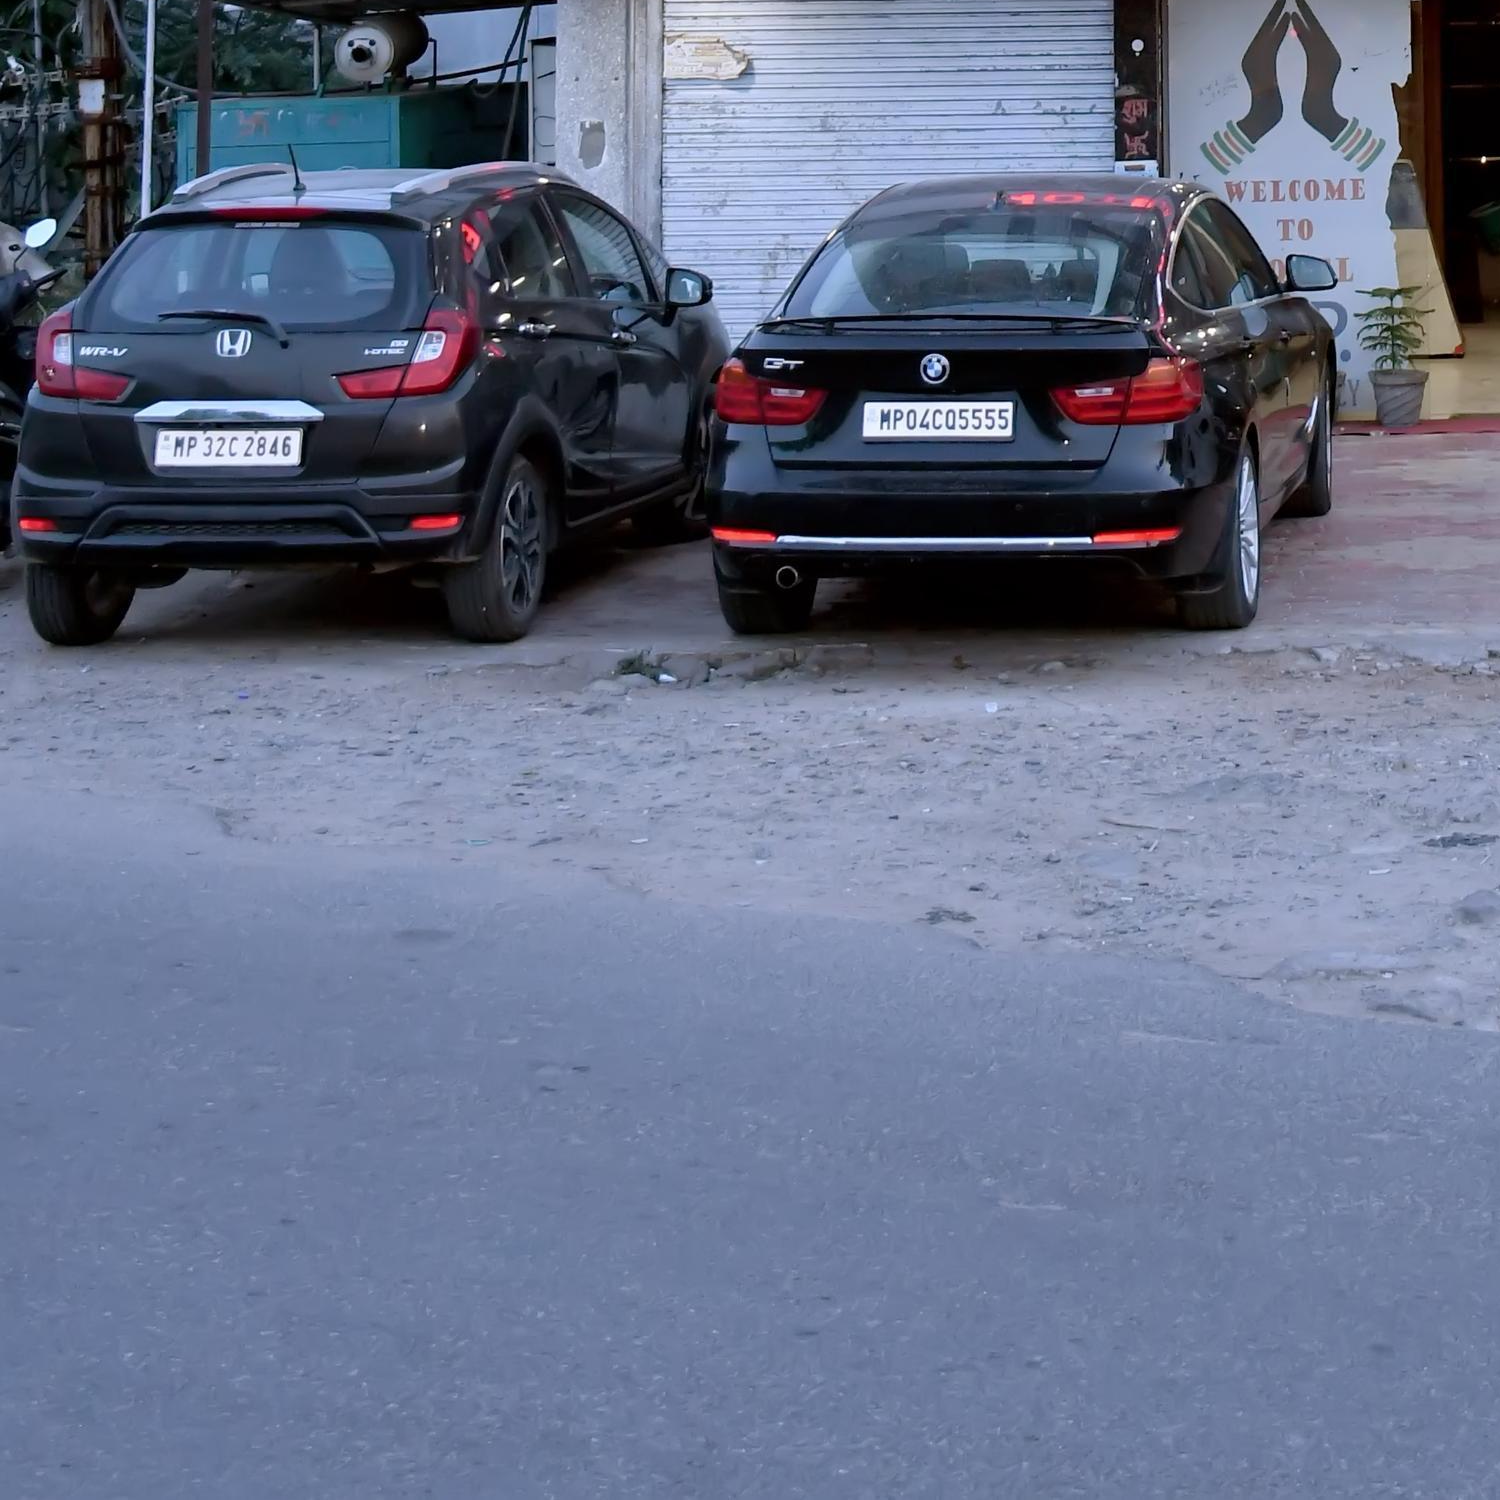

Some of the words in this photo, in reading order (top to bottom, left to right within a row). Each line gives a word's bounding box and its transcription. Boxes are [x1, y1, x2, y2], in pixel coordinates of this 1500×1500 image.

[1224, 178, 1366, 203] WELCOME
[1276, 218, 1313, 241] TO
[80, 346, 128, 356] WR-V
[763, 358, 804, 370] GT
